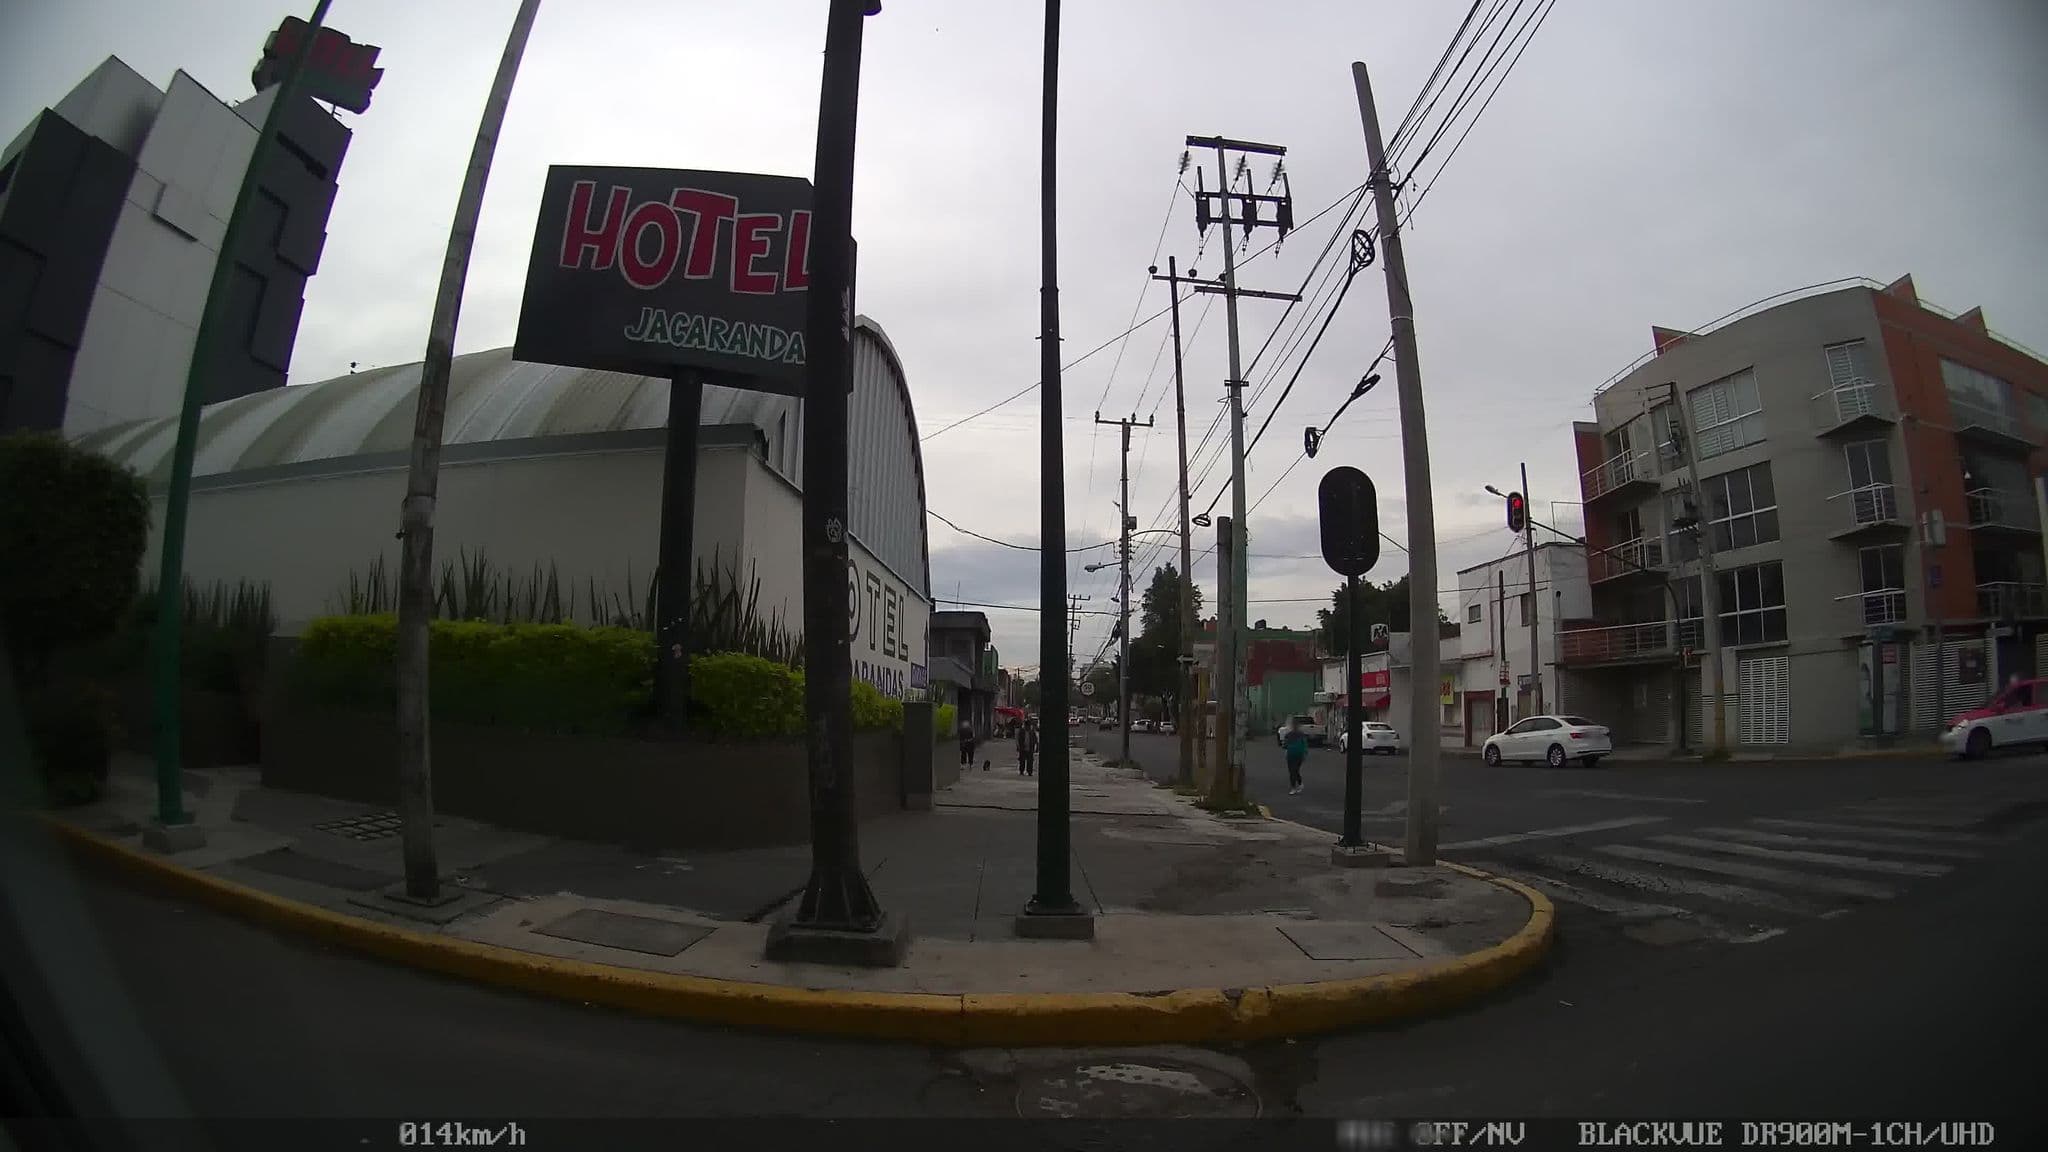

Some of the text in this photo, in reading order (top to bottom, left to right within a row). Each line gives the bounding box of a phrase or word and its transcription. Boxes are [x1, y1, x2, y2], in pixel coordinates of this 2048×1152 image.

[559, 180, 812, 294] HOTEL
[624, 307, 805, 364] JACARANDA
[850, 659, 905, 702] ARANDAS
